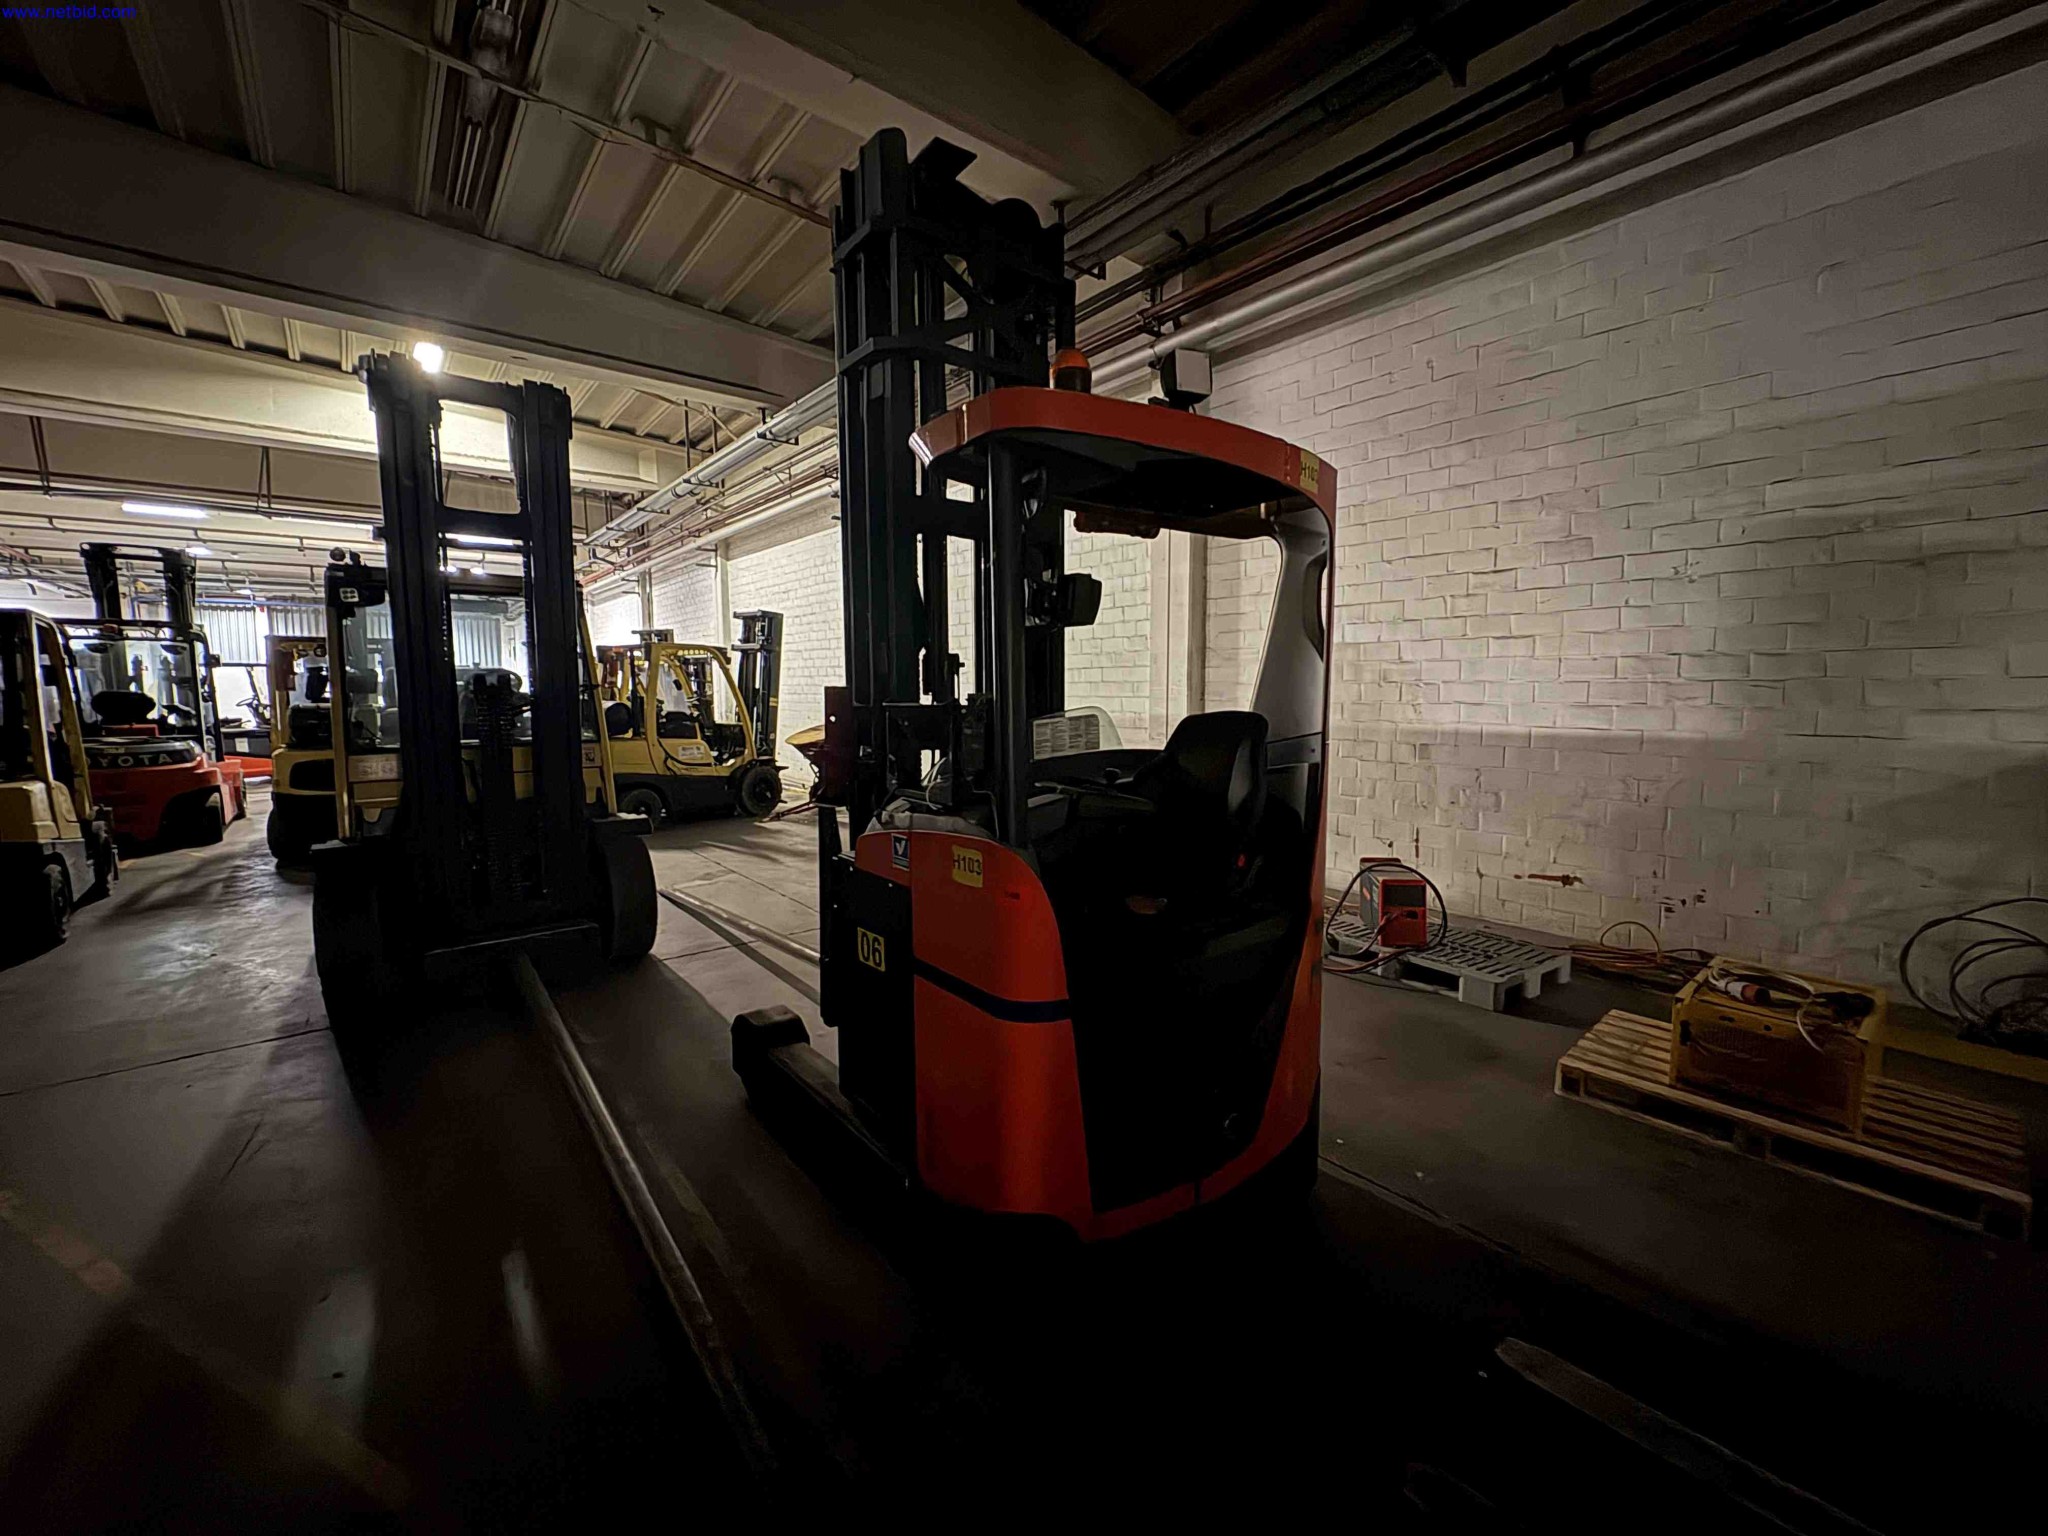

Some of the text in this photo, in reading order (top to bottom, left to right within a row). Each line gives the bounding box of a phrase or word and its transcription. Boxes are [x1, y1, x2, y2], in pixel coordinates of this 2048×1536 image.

[87, 753, 173, 767] YOTA
[952, 854, 982, 876] H103
[861, 931, 882, 968] 06
